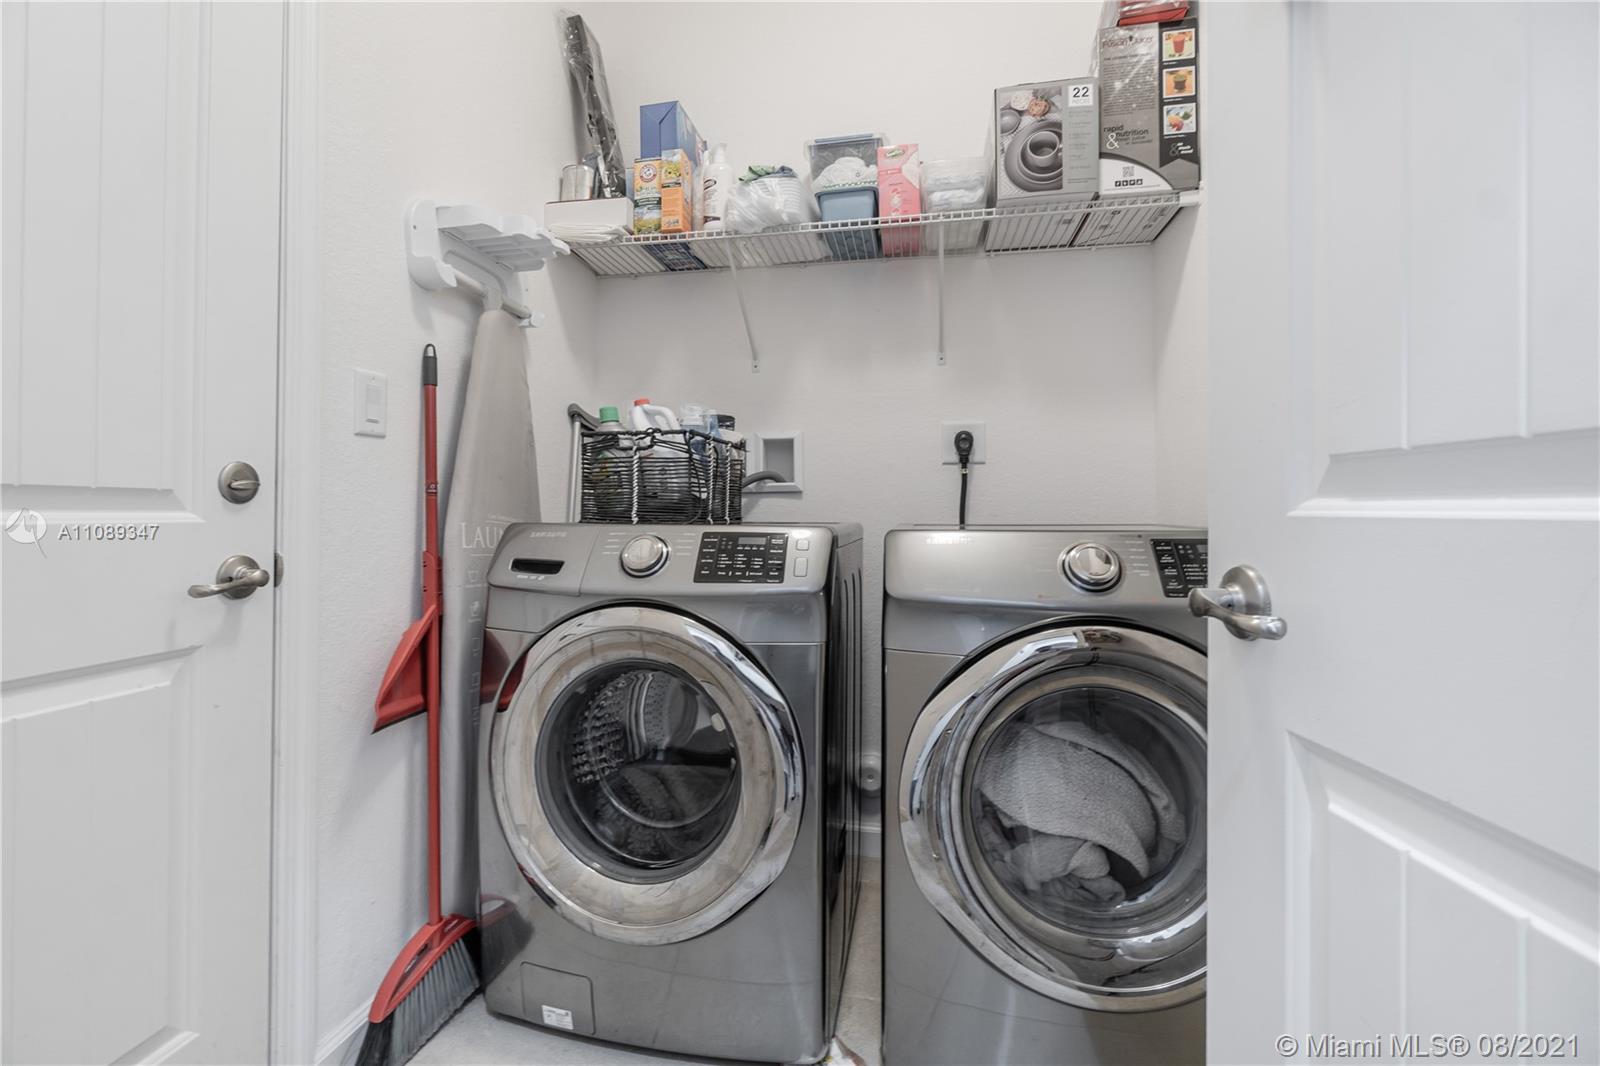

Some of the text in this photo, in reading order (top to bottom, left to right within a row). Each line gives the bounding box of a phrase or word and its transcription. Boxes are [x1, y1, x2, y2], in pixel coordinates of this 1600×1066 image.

[1072, 86, 1090, 98] 22
[1103, 124, 1125, 133] rapid
[1115, 128, 1149, 138] nutrition
